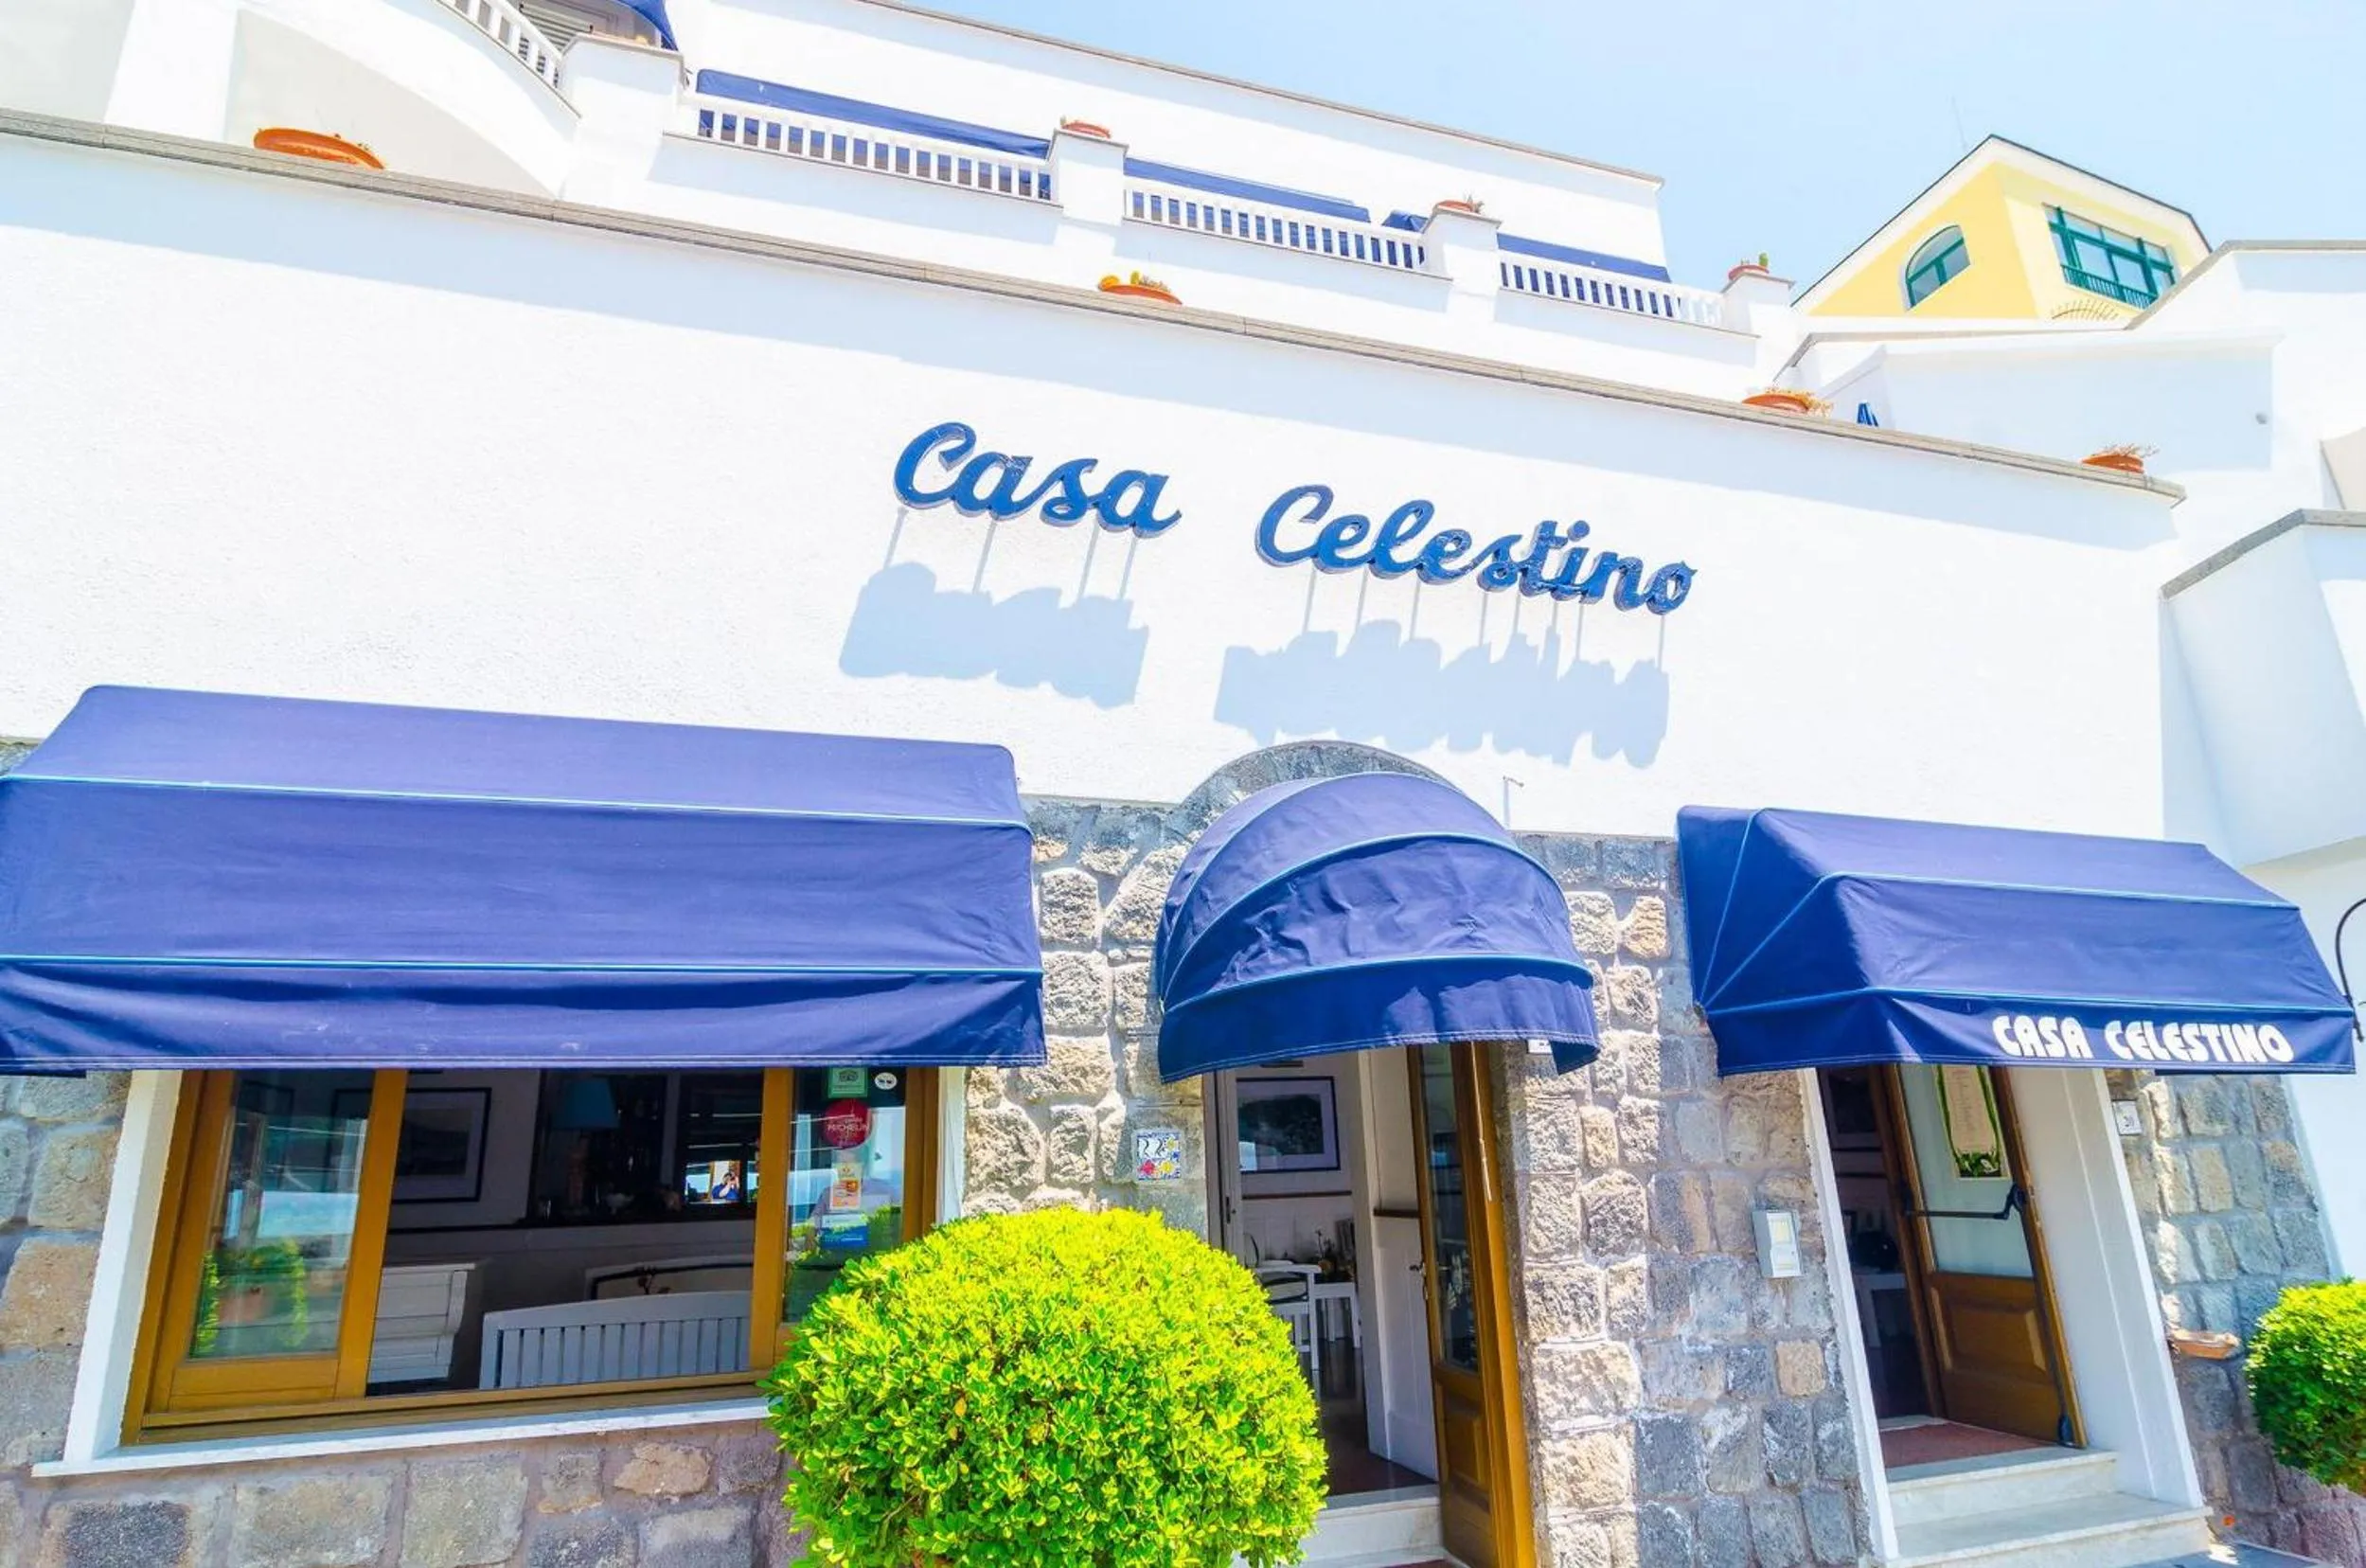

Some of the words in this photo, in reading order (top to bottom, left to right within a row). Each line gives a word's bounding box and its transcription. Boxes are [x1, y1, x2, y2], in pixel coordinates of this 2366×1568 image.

[895, 421, 1181, 537] Casa
[1255, 486, 1698, 615] Celestino
[1992, 1015, 2093, 1059] CASA
[2105, 1021, 2295, 1062] CELESTINO
